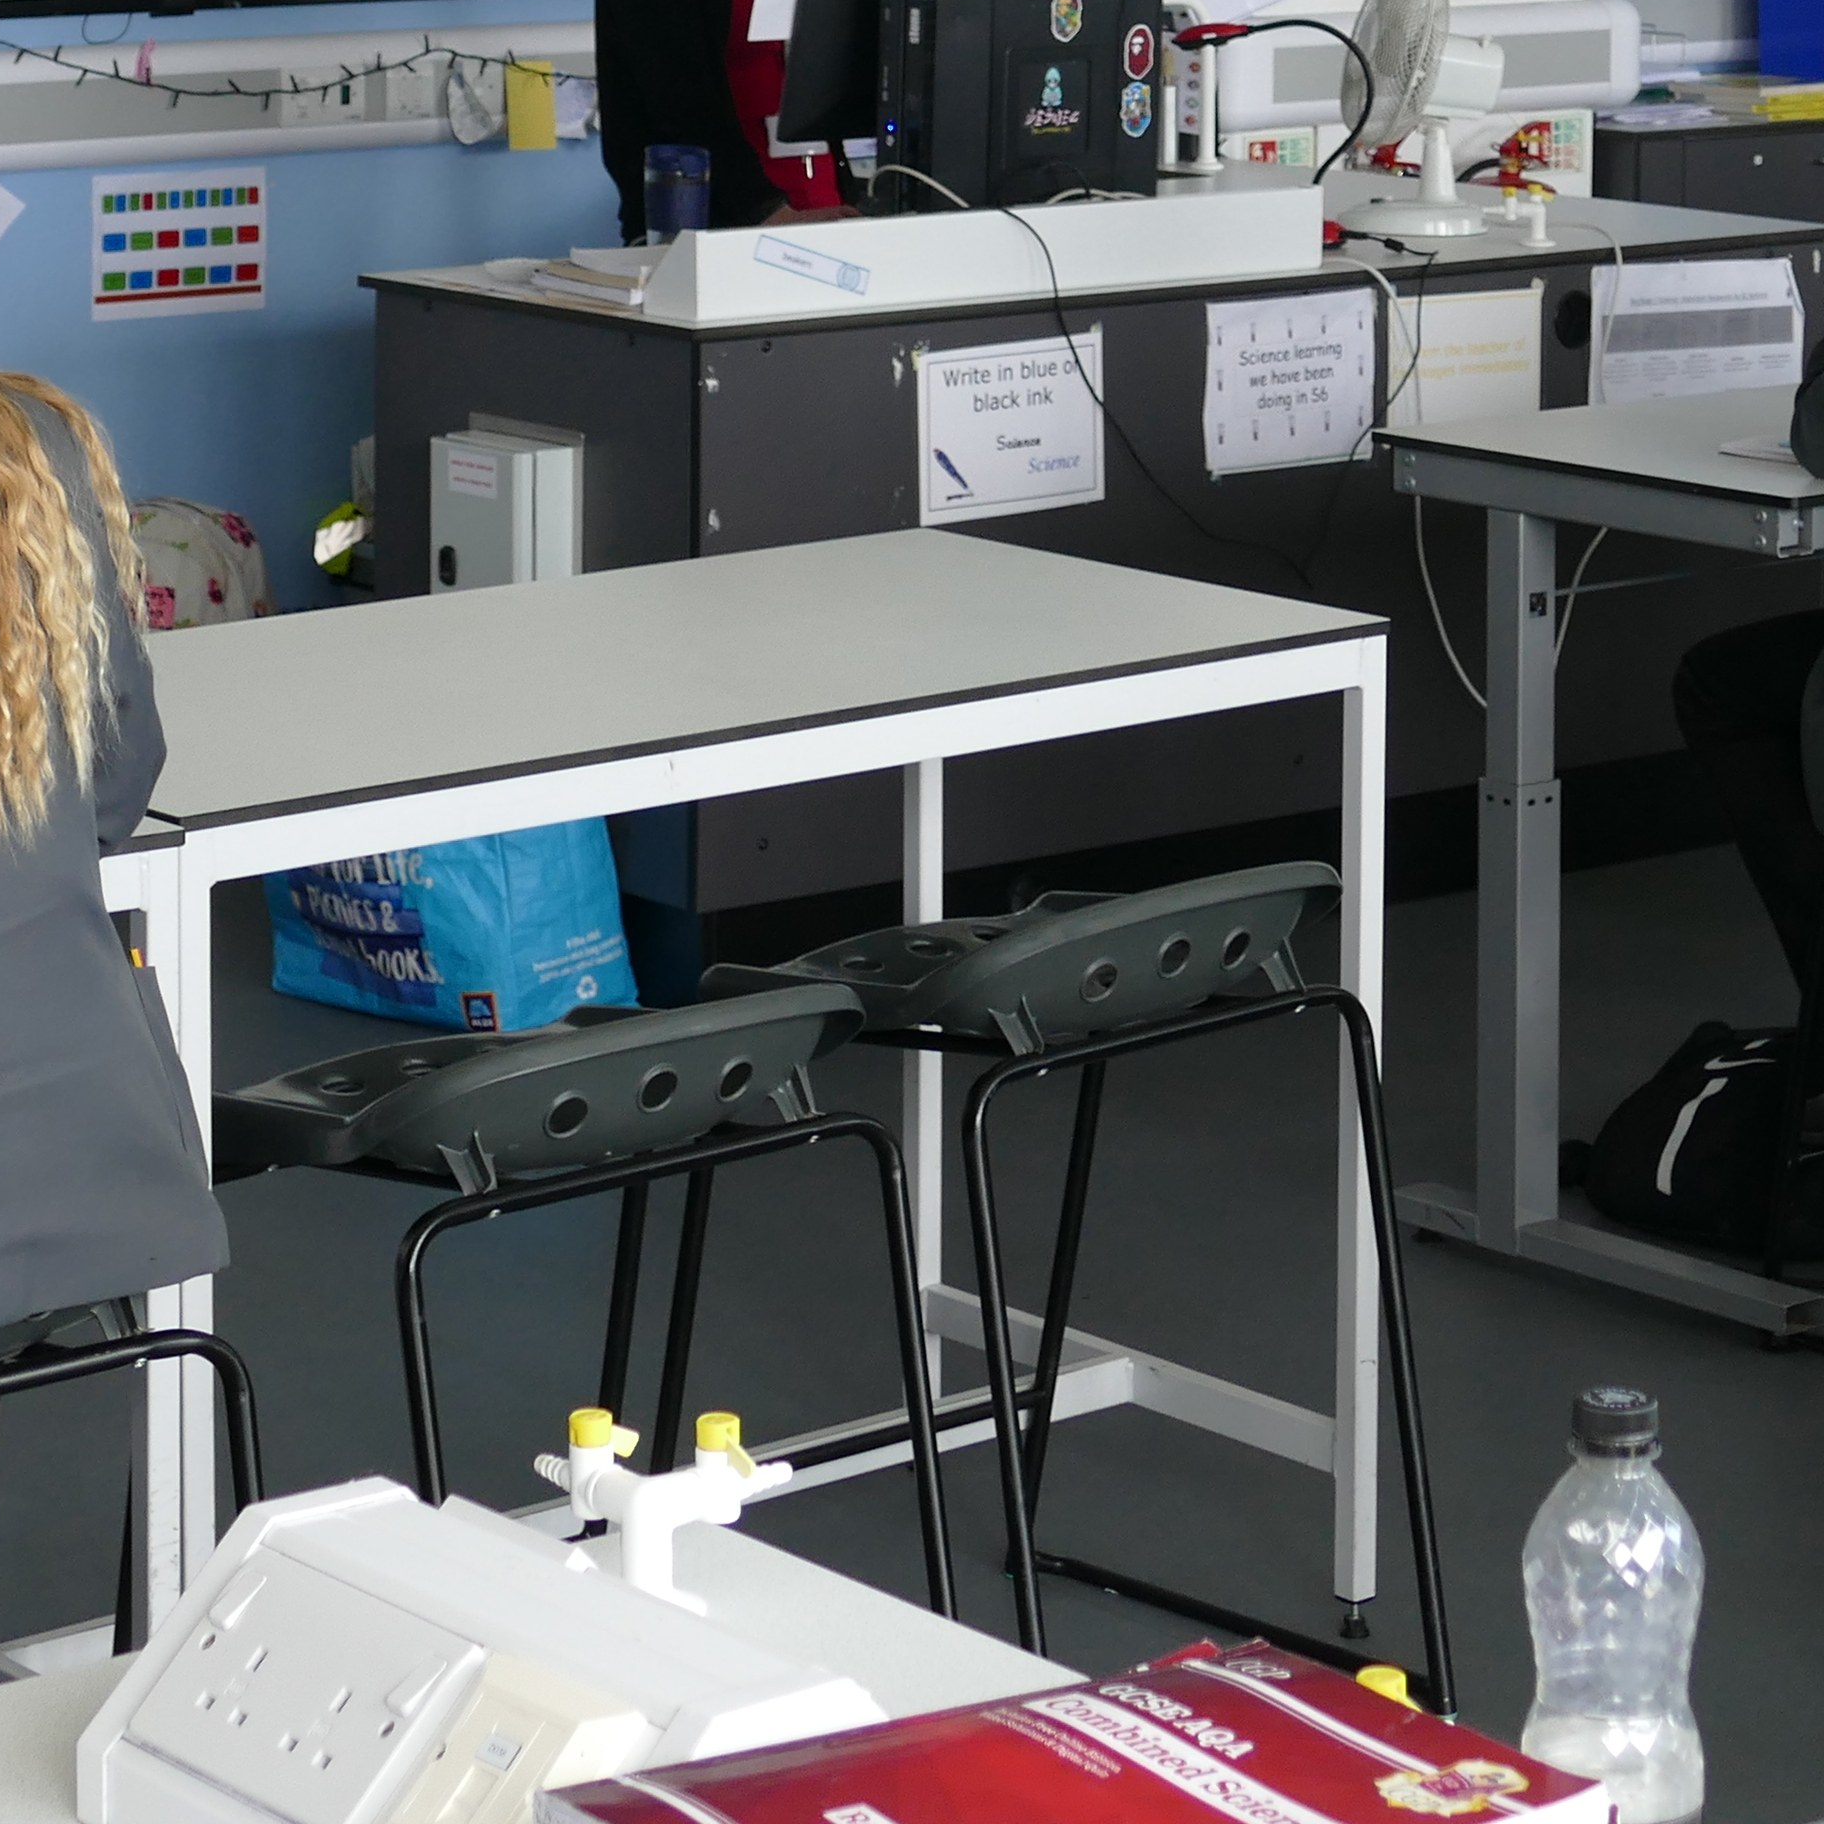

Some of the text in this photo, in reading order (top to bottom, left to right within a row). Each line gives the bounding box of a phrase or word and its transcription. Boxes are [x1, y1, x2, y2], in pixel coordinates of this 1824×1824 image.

[1238, 341, 1343, 367] Science learning
[942, 364, 991, 388] Write
[997, 365, 1013, 382] in
[1020, 360, 1058, 381] blue
[1249, 365, 1334, 388] we have been
[973, 387, 1054, 413] black ink
[1257, 387, 1329, 411] doing in S6
[996, 435, 1042, 451] Science
[1026, 453, 1080, 475] Science
[1098, 1683, 1254, 1760] GCSE AQA
[1045, 1696, 1218, 1781] Combined
